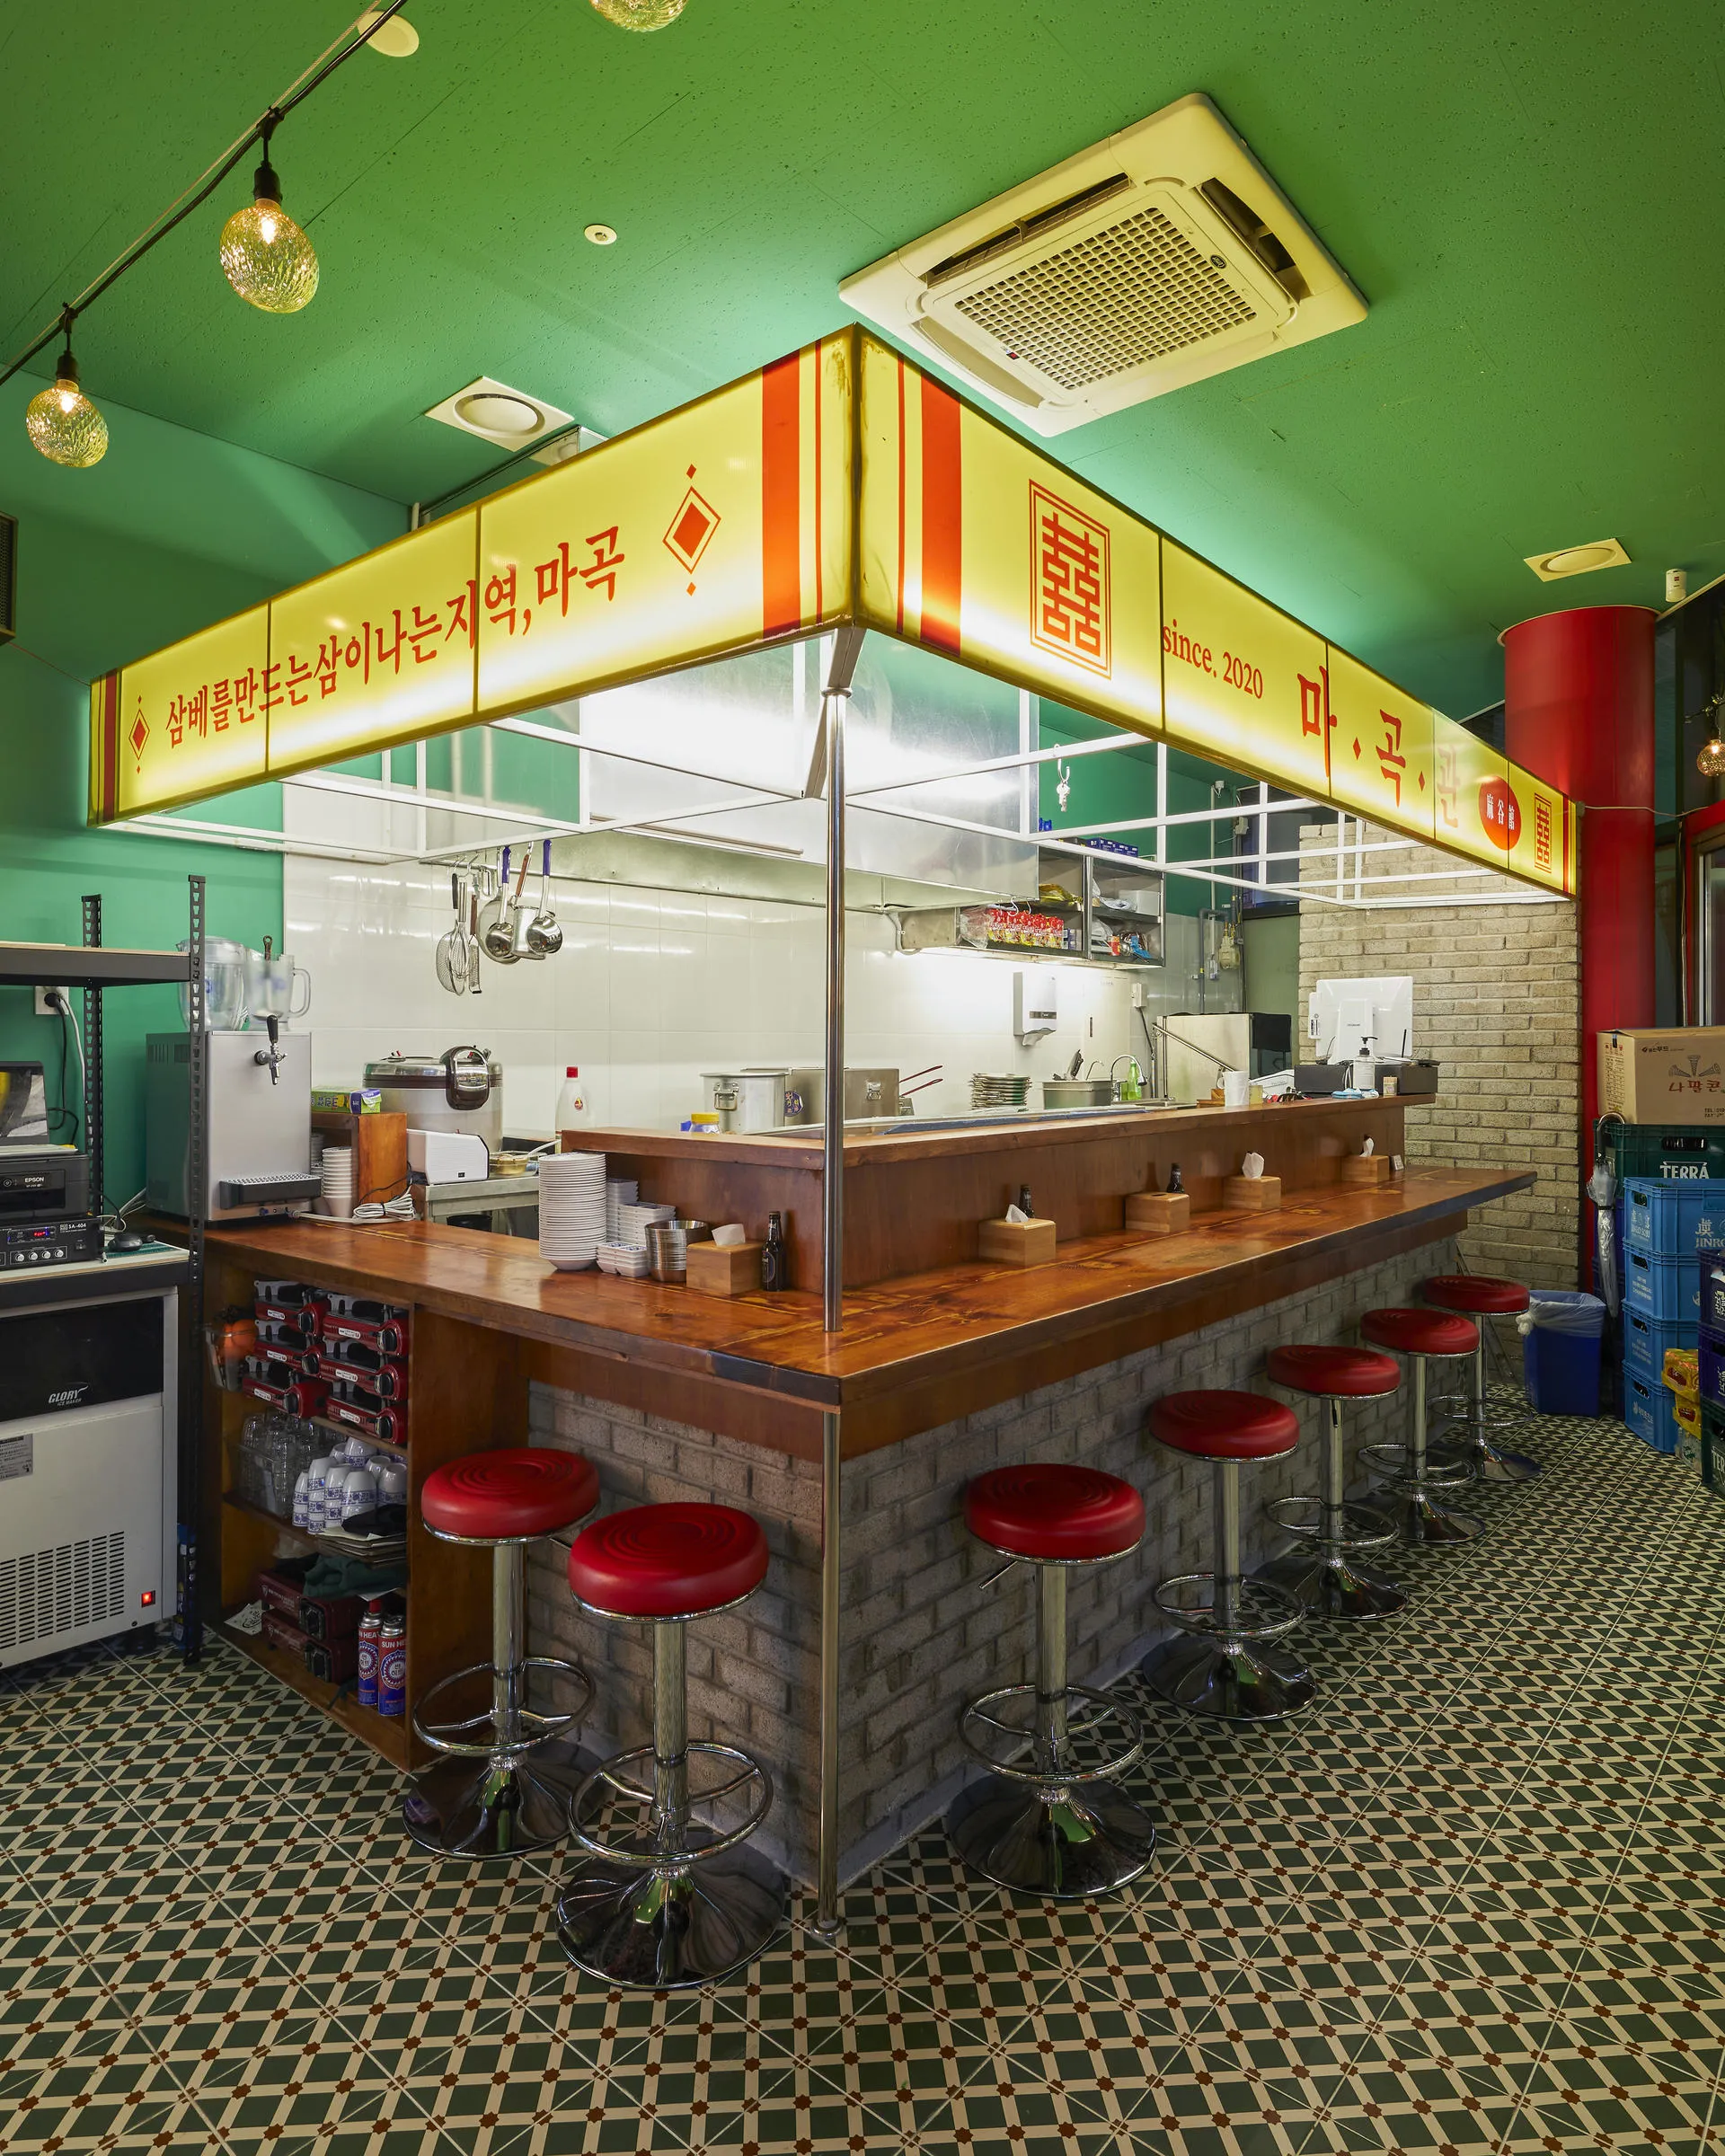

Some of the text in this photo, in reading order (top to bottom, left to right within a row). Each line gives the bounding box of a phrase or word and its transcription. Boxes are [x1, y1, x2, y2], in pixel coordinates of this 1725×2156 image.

[1163, 618, 1263, 700] since. 2020
[1659, 1162, 1710, 1180] TERRA
[48, 1389, 81, 1404] GLORY
